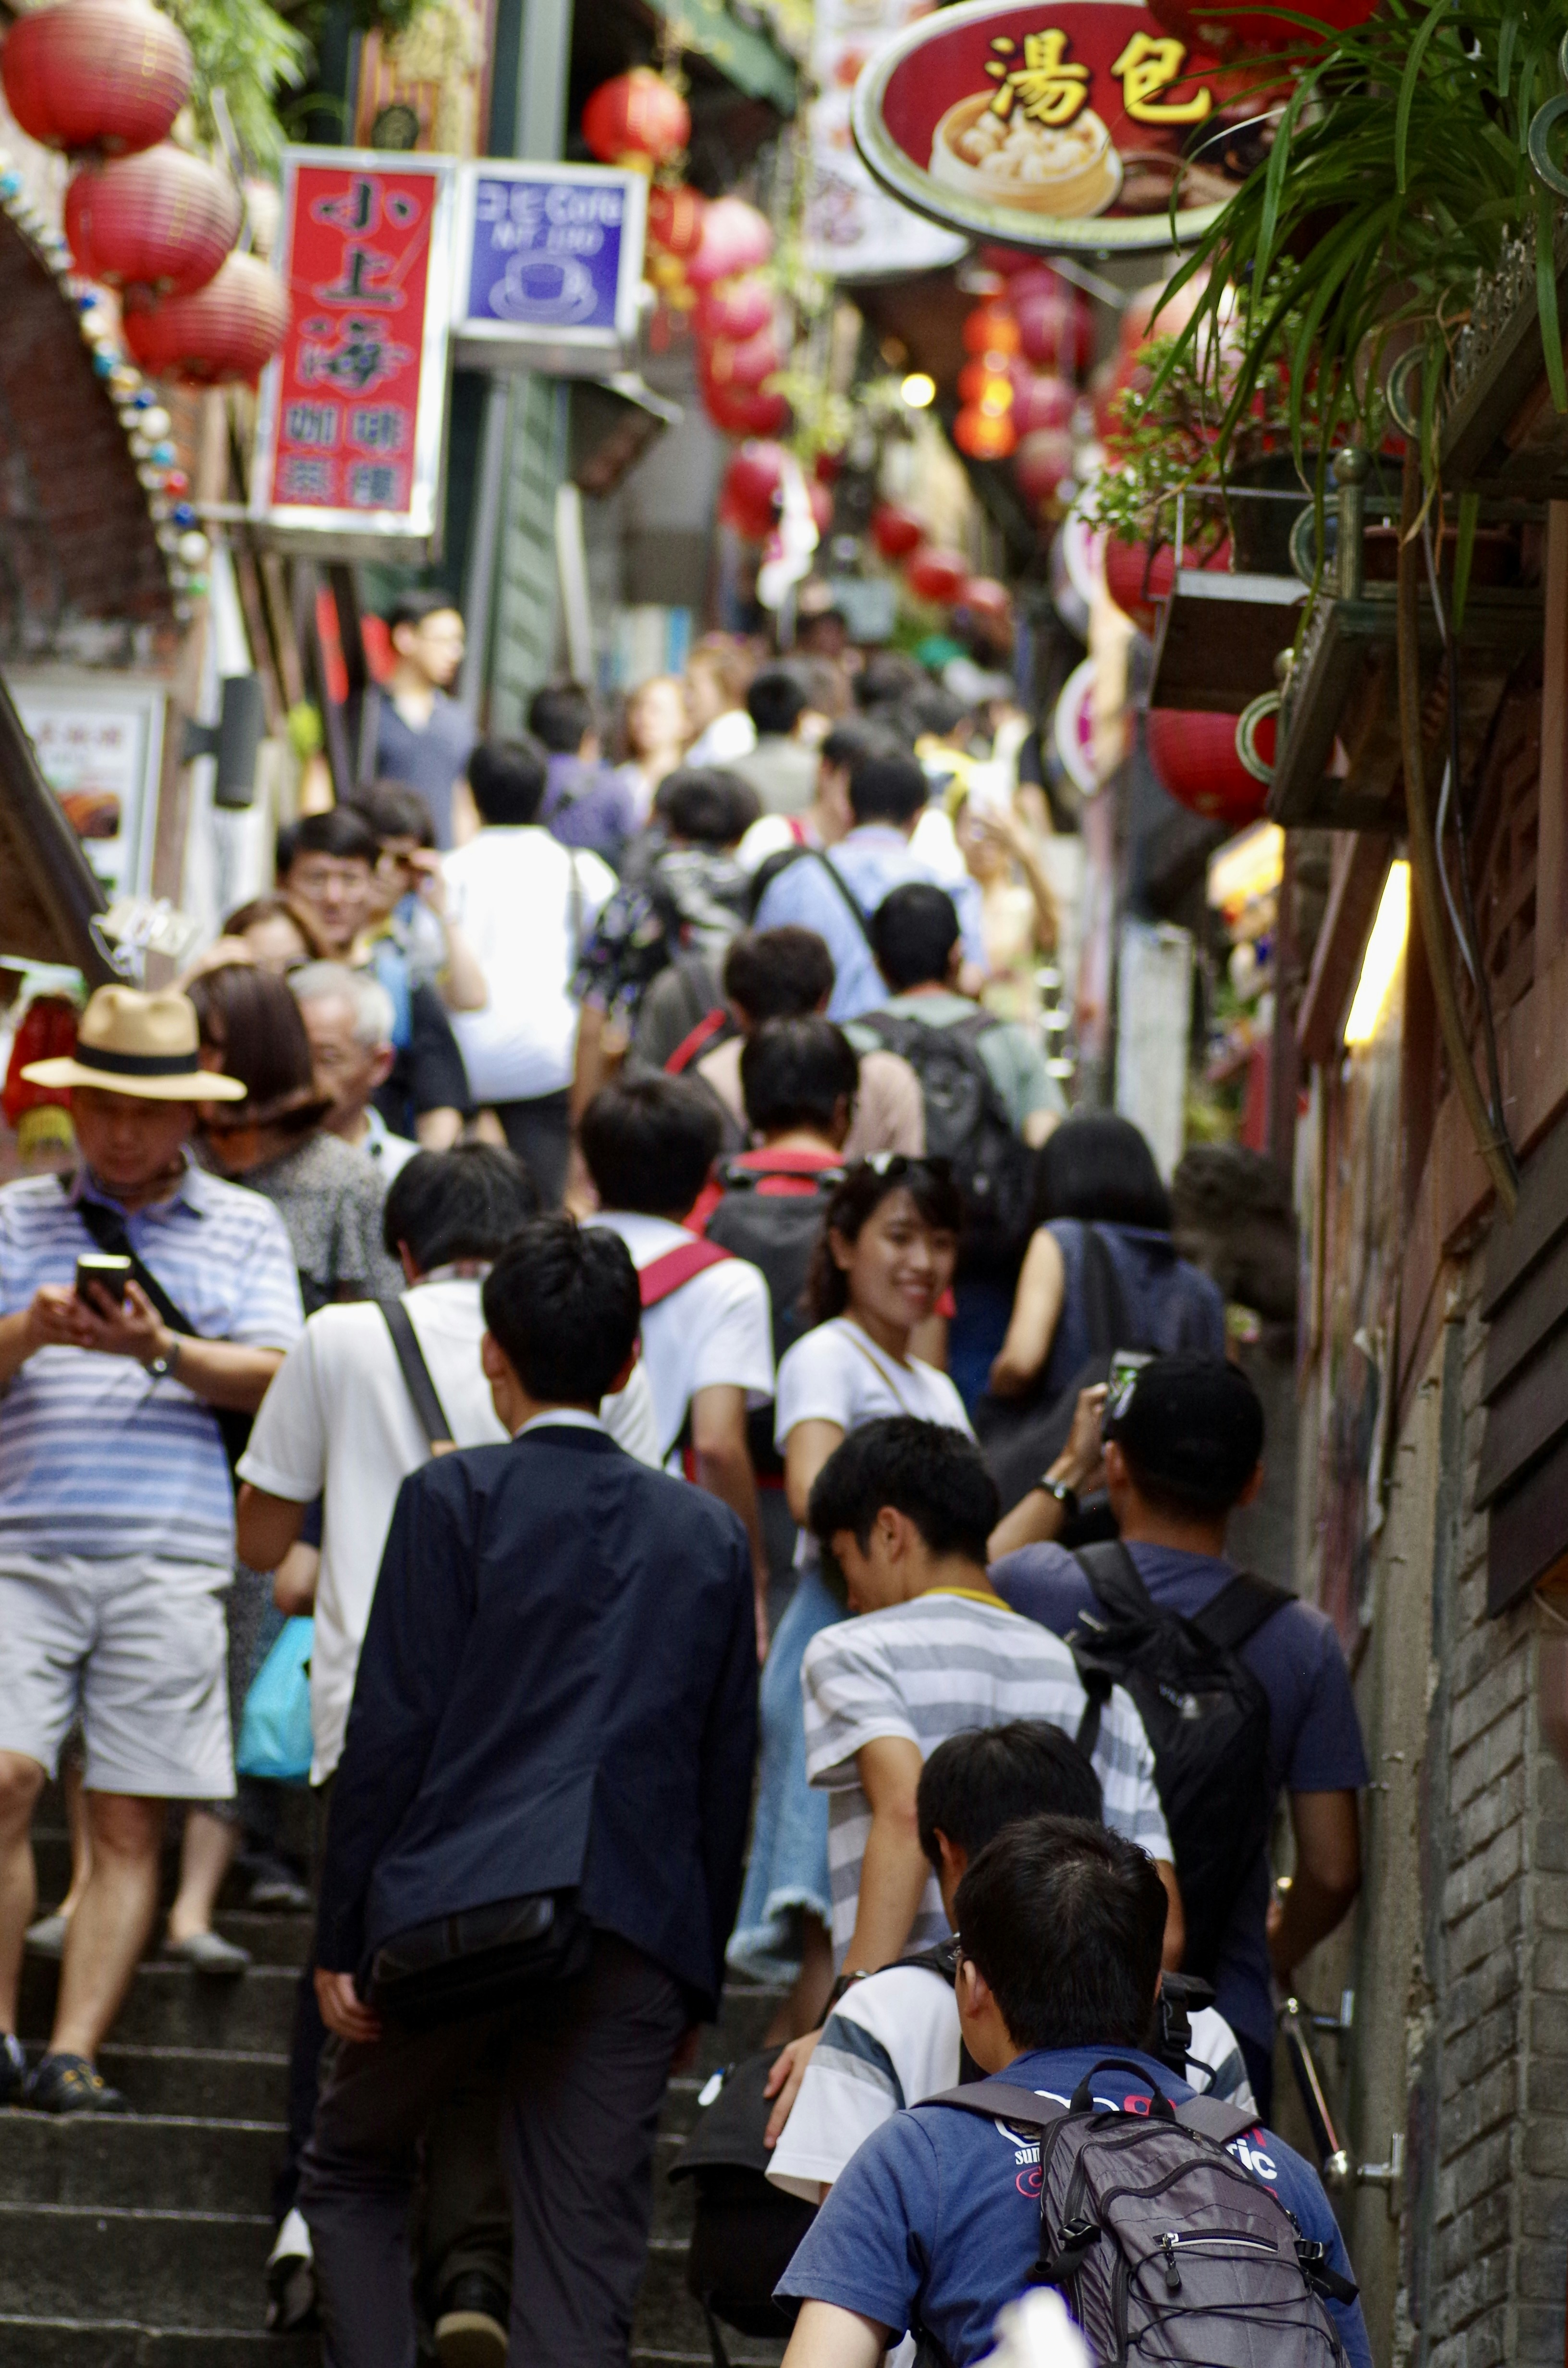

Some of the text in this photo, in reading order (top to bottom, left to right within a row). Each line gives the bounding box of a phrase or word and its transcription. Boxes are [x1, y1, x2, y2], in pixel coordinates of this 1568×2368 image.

[984, 28, 1212, 126] 湯包
[301, 176, 416, 390] 小上海
[284, 403, 404, 450] 咖啡
